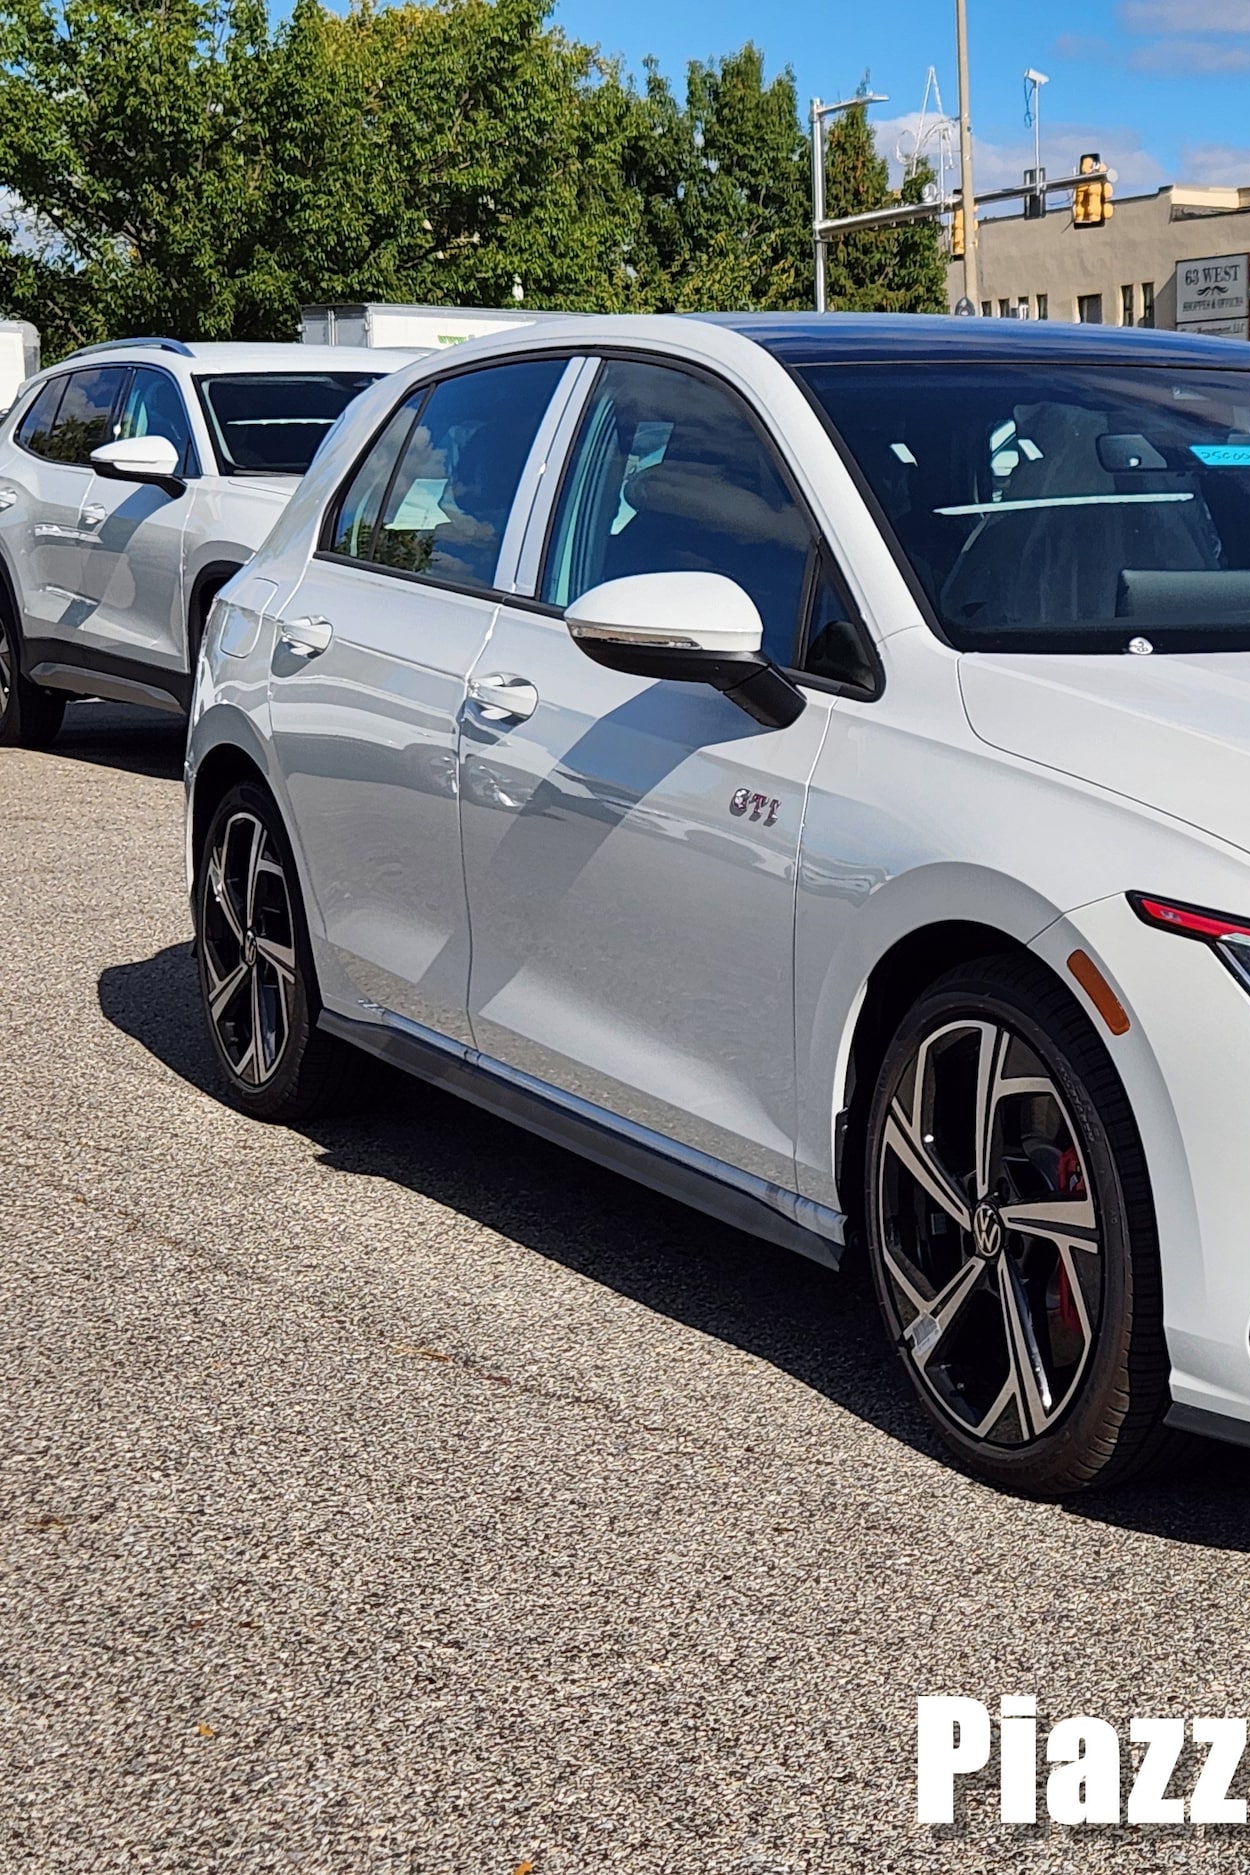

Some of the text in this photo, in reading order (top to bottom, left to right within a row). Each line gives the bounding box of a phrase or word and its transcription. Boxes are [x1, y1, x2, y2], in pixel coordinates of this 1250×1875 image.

[1185, 264, 1240, 286] 63 WEST
[730, 788, 781, 827] GTI
